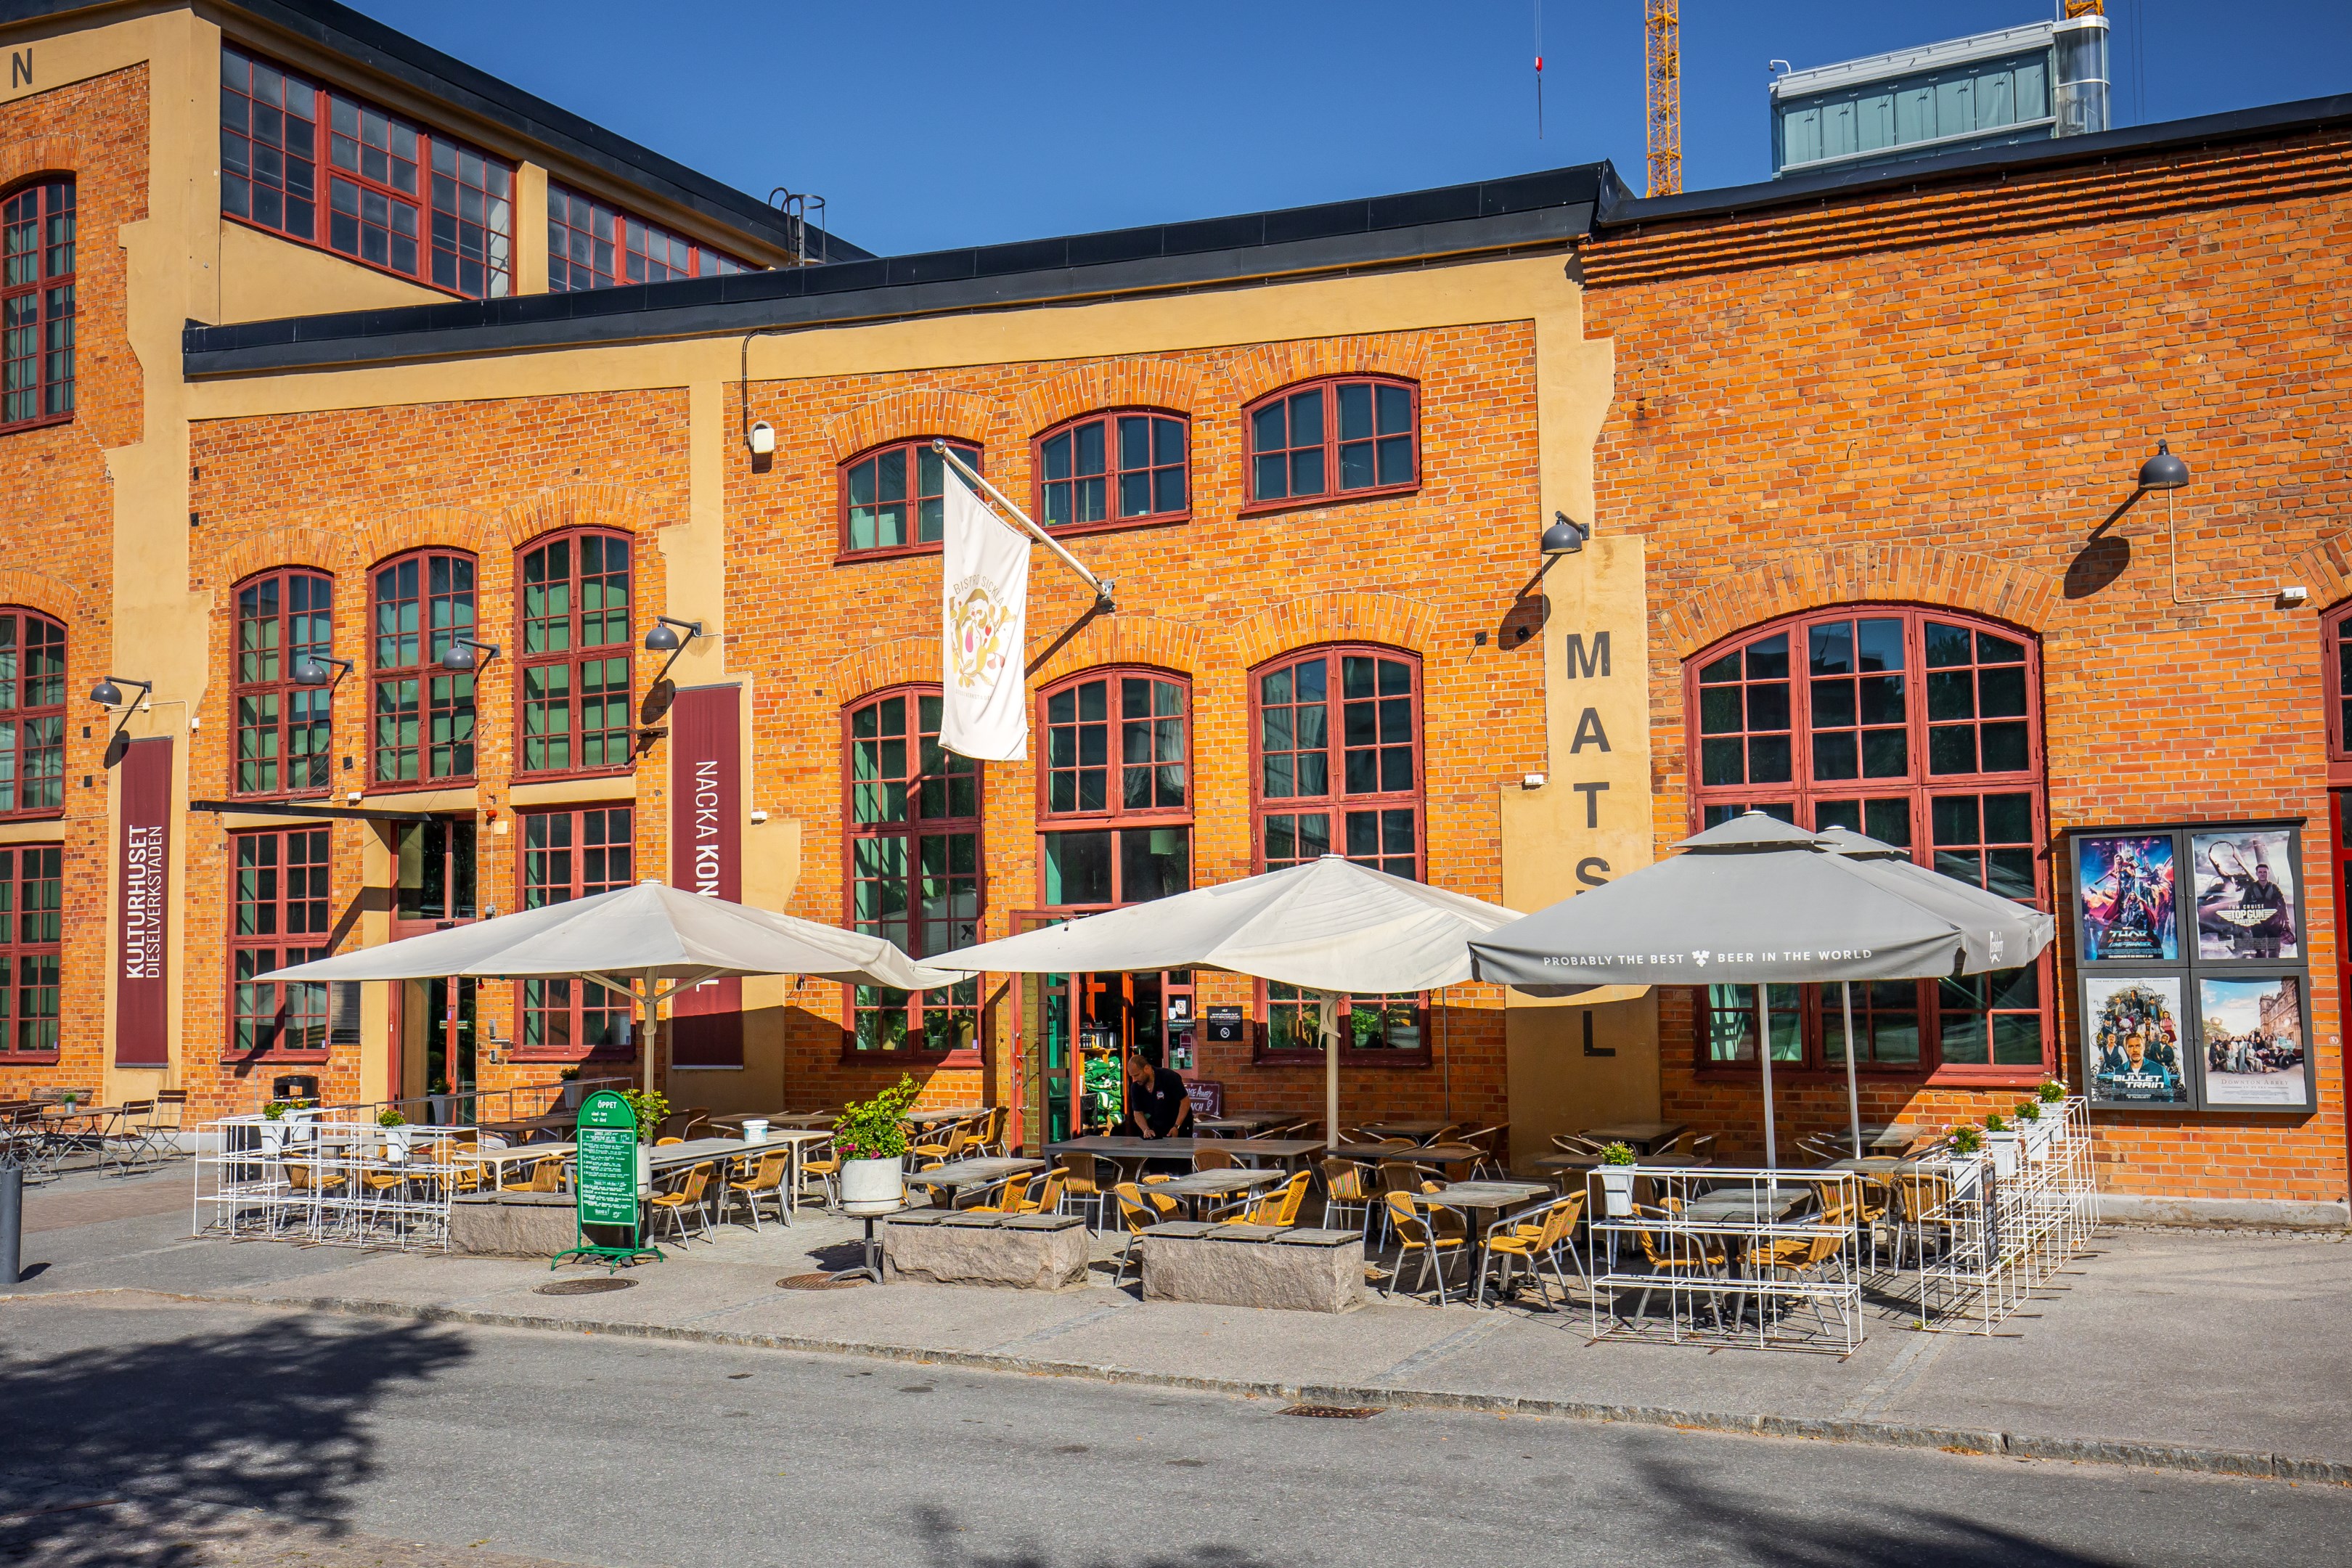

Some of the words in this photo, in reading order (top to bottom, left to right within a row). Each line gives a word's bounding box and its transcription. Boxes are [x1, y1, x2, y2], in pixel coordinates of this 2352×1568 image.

[953, 574, 980, 595] BISTRO
[981, 576, 1005, 607] SICKLA
[695, 761, 718, 839] NACKA
[1567, 631, 1617, 1057] MATSL
[126, 825, 147, 979] KULTURHUSET
[147, 825, 163, 979] DIESELVERKSTADEN
[2231, 909, 2247, 919] TOP
[2247, 909, 2264, 918] GUN
[1543, 955, 1612, 966] PROBABLY
[1617, 955, 1643, 965] THE
[1650, 954, 1684, 964] BEST
[1718, 952, 1754, 963] BEER
[1762, 952, 1776, 962] IN
[1783, 951, 1810, 961] THE
[1818, 950, 1872, 960] WORLD
[597, 1100, 617, 1108] ÖPPET
